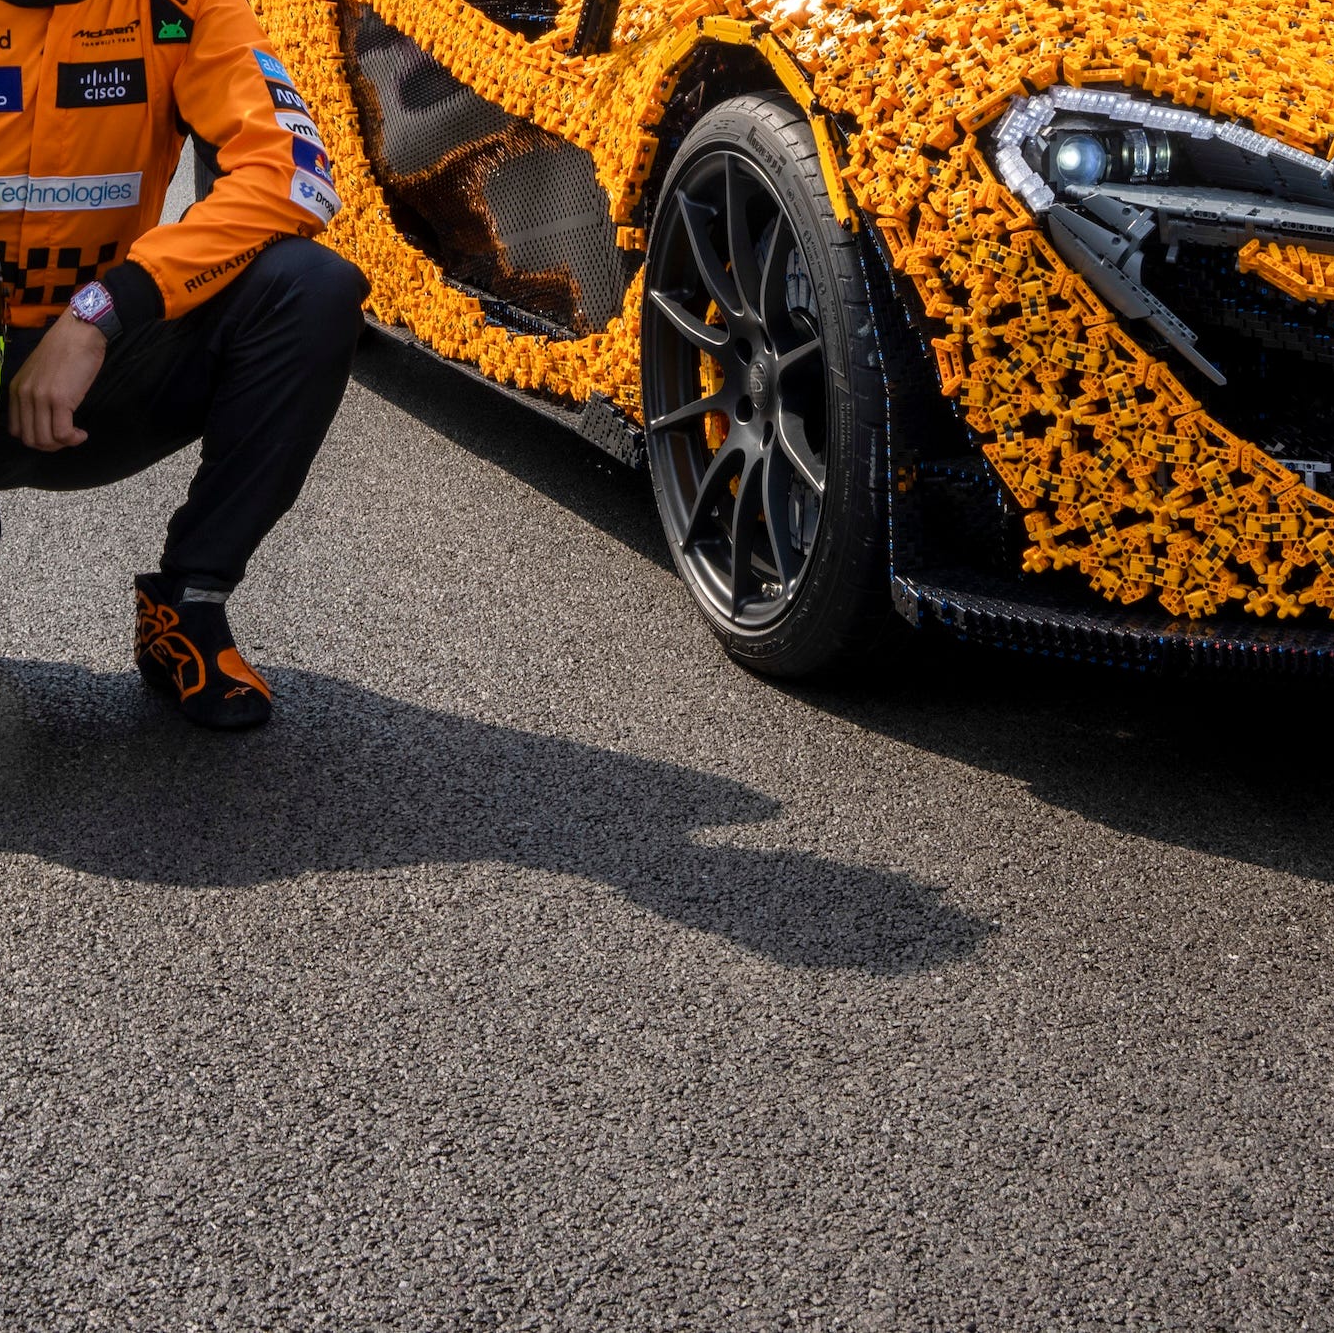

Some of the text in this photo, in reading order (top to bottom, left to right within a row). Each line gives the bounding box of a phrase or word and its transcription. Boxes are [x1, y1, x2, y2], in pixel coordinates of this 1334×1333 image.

[72, 25, 134, 39] McLaren
[83, 86, 126, 100] CISCO
[183, 247, 258, 294] RICHARD
